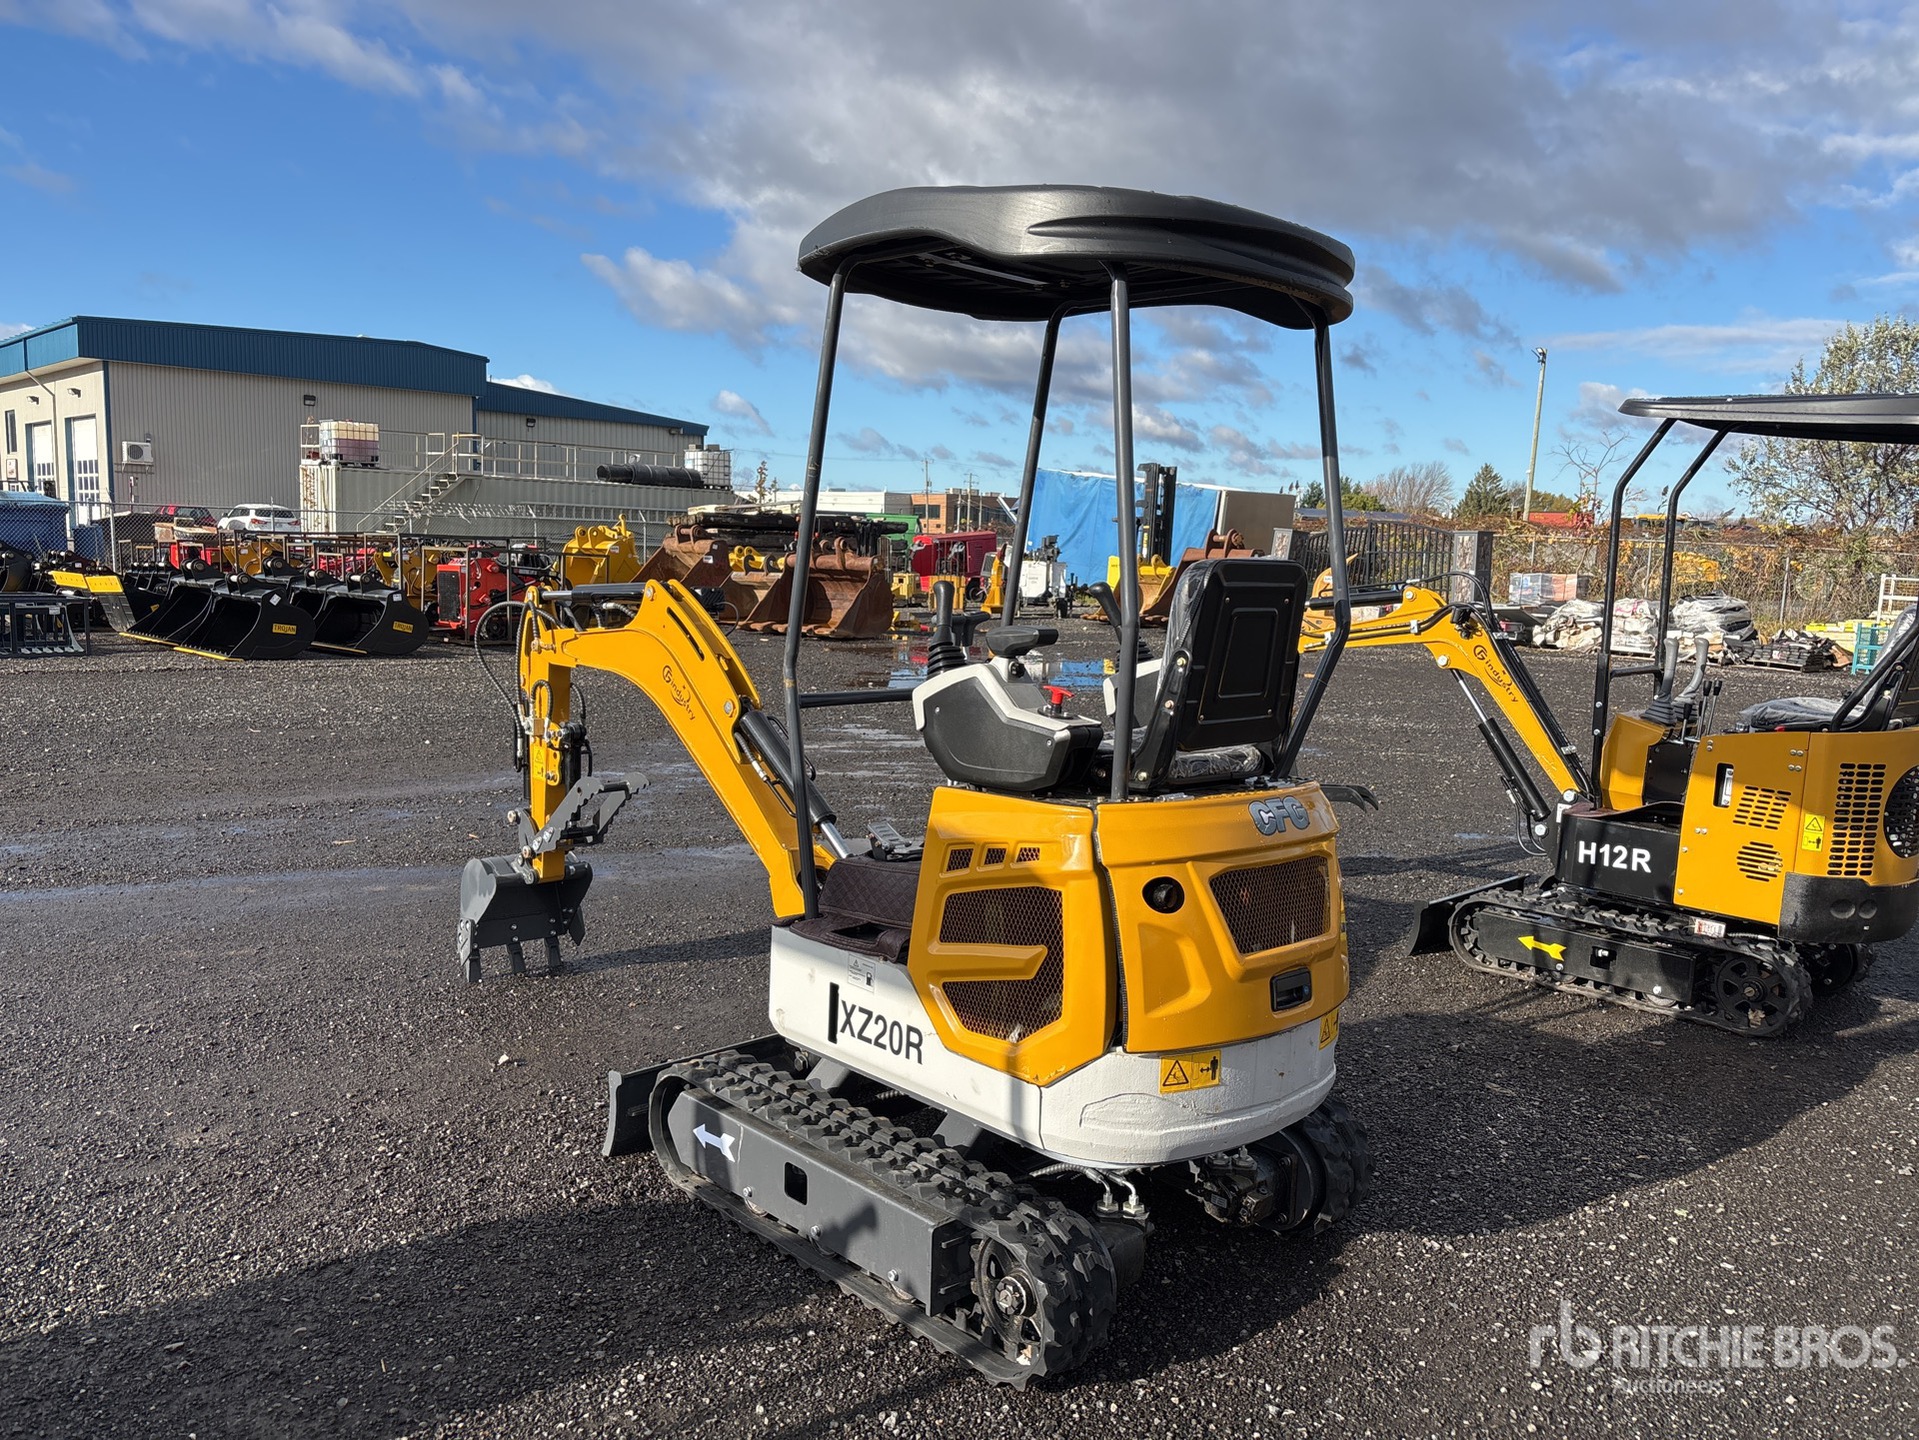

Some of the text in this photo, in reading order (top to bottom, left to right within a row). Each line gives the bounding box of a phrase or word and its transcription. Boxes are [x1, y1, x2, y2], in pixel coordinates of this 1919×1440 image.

[273, 624, 296, 634] TROJAN
[1248, 795, 1311, 836] CFG
[1577, 840, 1653, 873] H12R
[839, 998, 924, 1065] XZ20R
